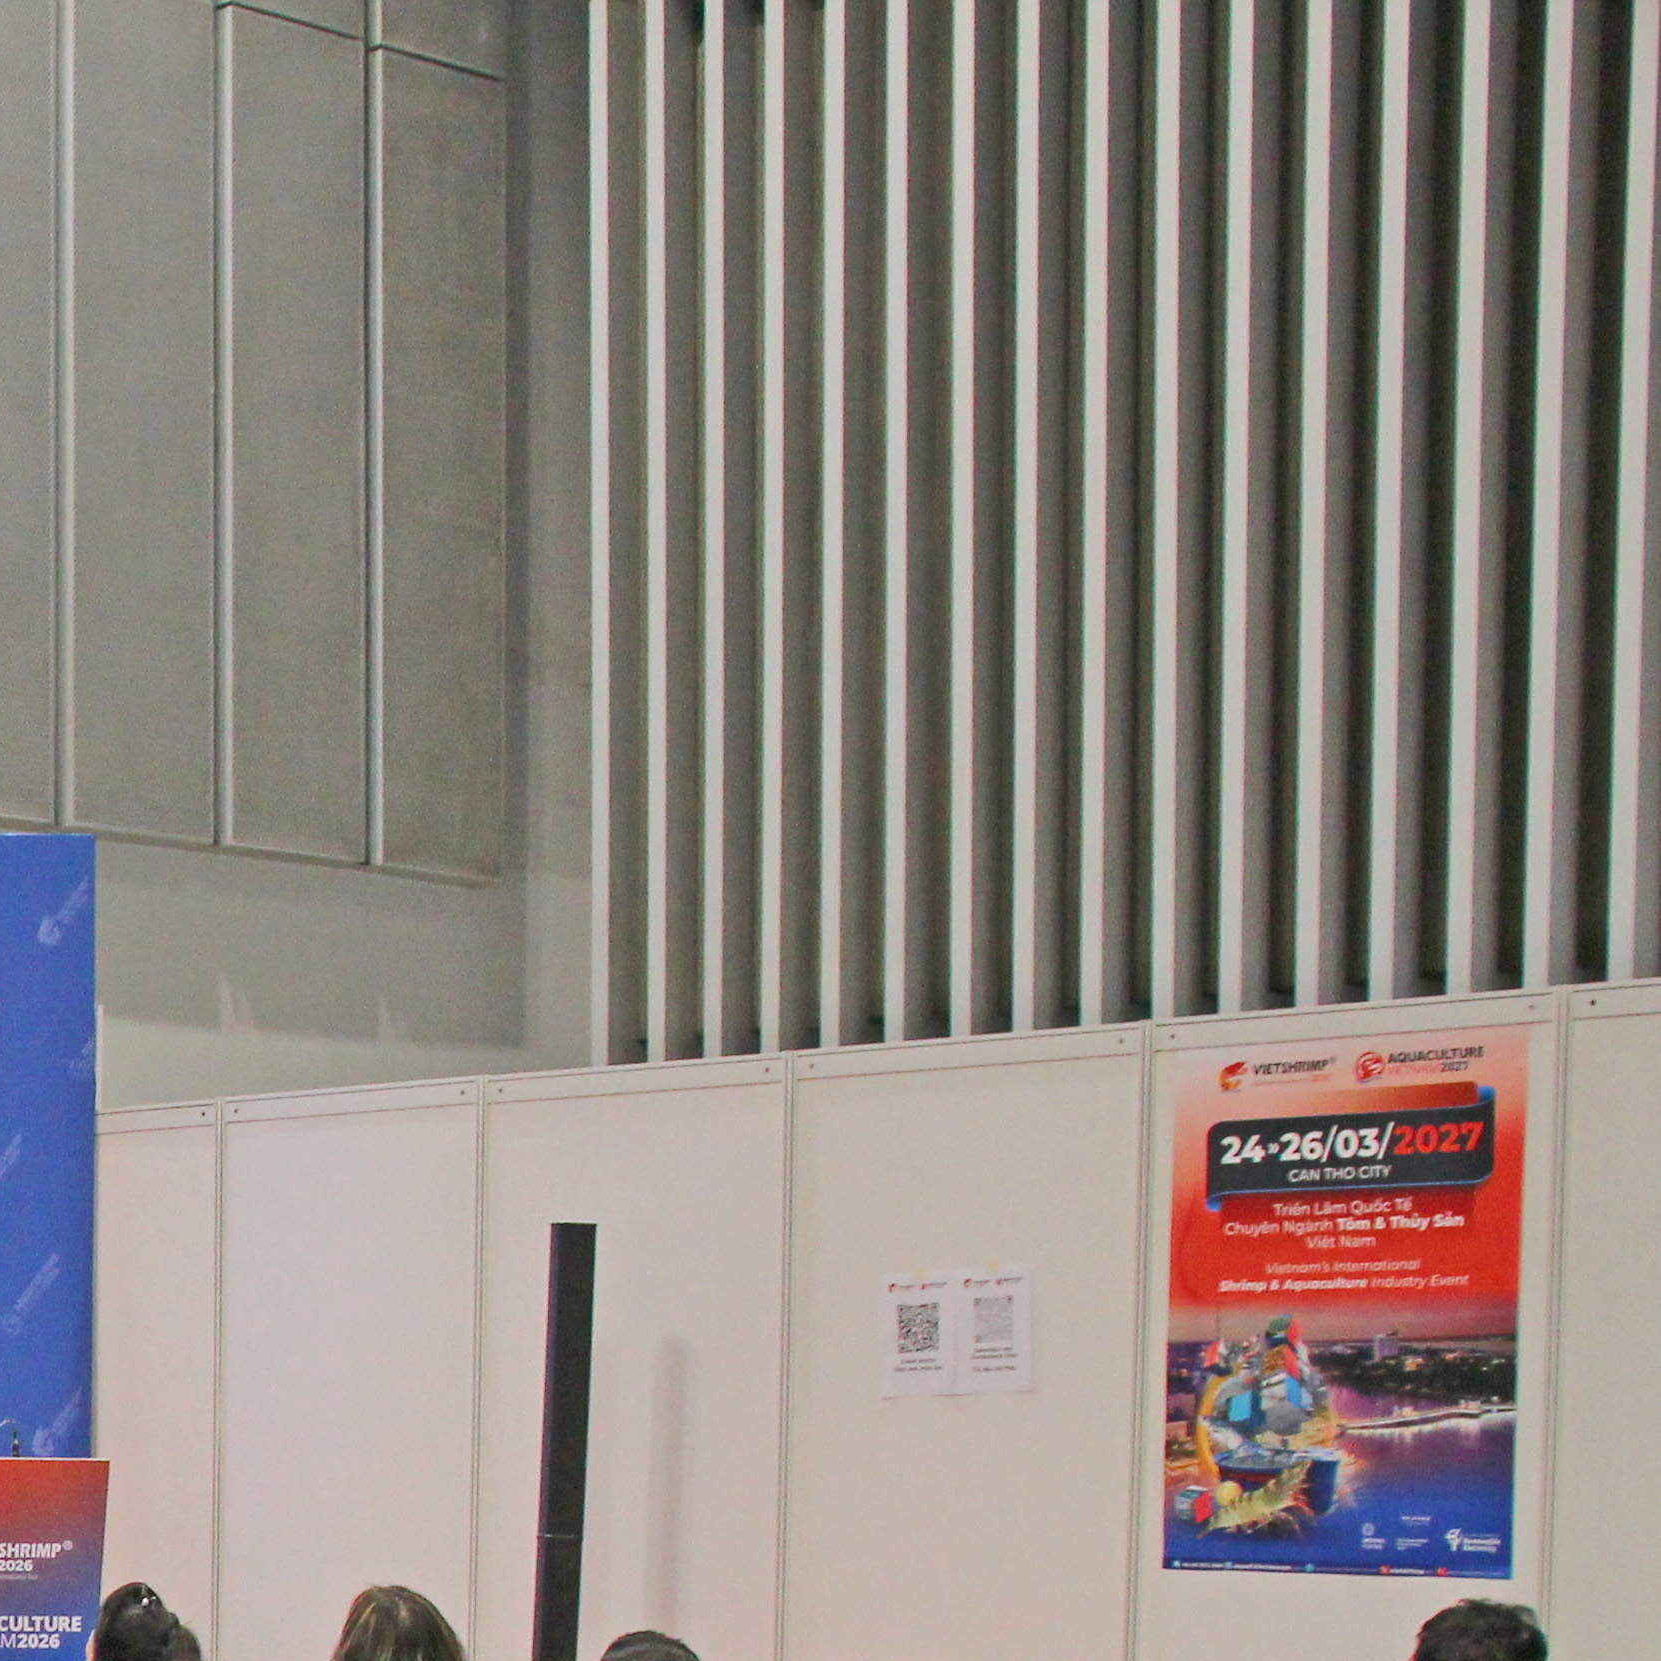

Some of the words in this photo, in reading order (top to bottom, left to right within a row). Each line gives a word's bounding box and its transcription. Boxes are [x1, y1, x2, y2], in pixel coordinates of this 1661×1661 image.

[1388, 1046, 1485, 1065] AQUACULTURE
[1287, 1168, 1321, 1183] CAN
[1323, 1166, 1356, 1181] THO
[1359, 1164, 1392, 1179] CITY
[1340, 1234, 1377, 1248] Nam
[1333, 1258, 1422, 1273] International
[1219, 1279, 1267, 1294] Shrimp
[1282, 1277, 1369, 1292] Aquaculture
[1371, 1276, 1427, 1291] Industry
[1430, 1274, 1470, 1288] Event
